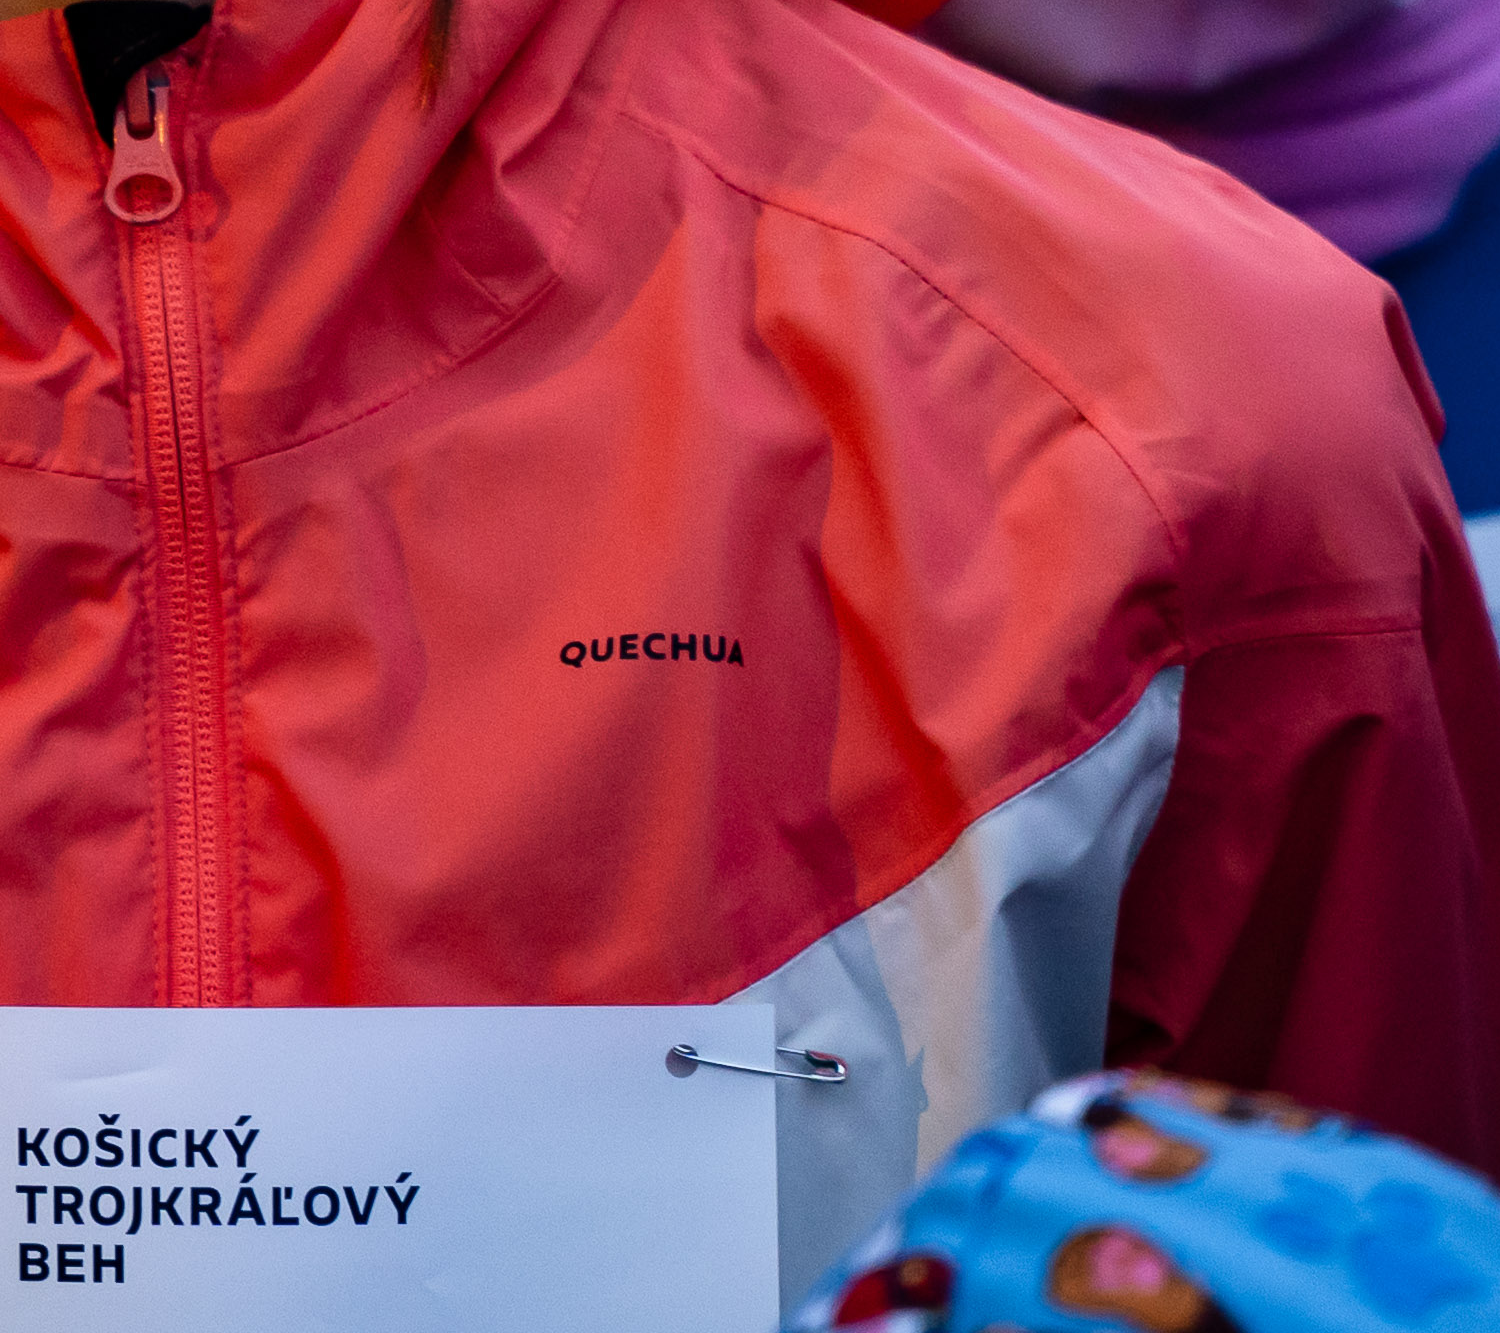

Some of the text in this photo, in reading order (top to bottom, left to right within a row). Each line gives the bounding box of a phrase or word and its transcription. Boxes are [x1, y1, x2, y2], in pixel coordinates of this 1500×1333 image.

[559, 632, 745, 669] QUECHUA
[16, 1112, 261, 1169] KOŠICKÝ
[14, 1171, 421, 1236] TROJKRÁĽOVÝ
[18, 1242, 126, 1284] BEH
